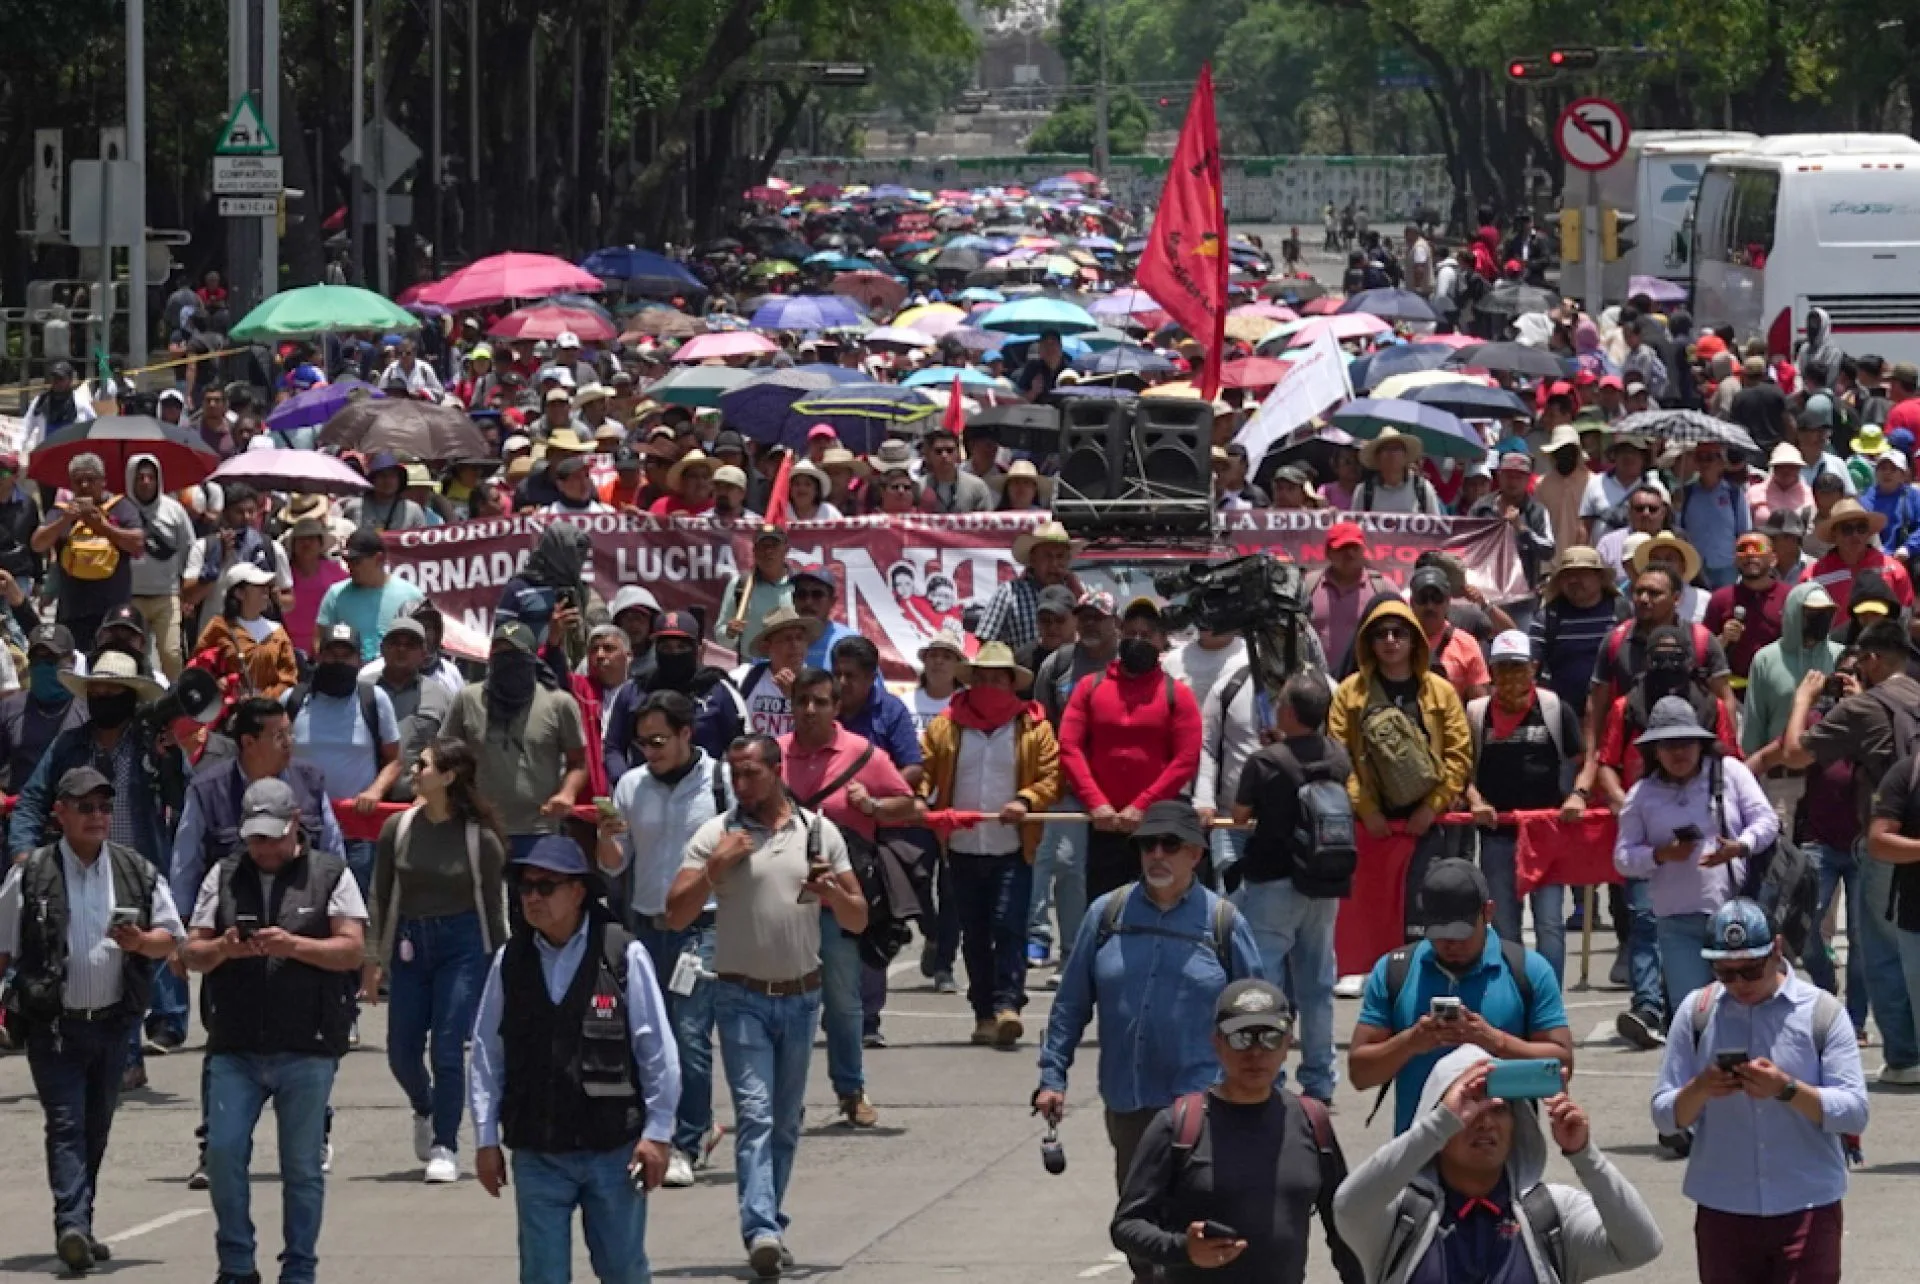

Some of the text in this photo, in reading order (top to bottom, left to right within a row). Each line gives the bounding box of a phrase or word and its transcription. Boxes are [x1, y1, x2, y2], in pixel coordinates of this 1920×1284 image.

[219, 170, 279, 178] COMPARTIDO
[233, 201, 274, 212] INICIA
[616, 545, 740, 582] LUCHA
